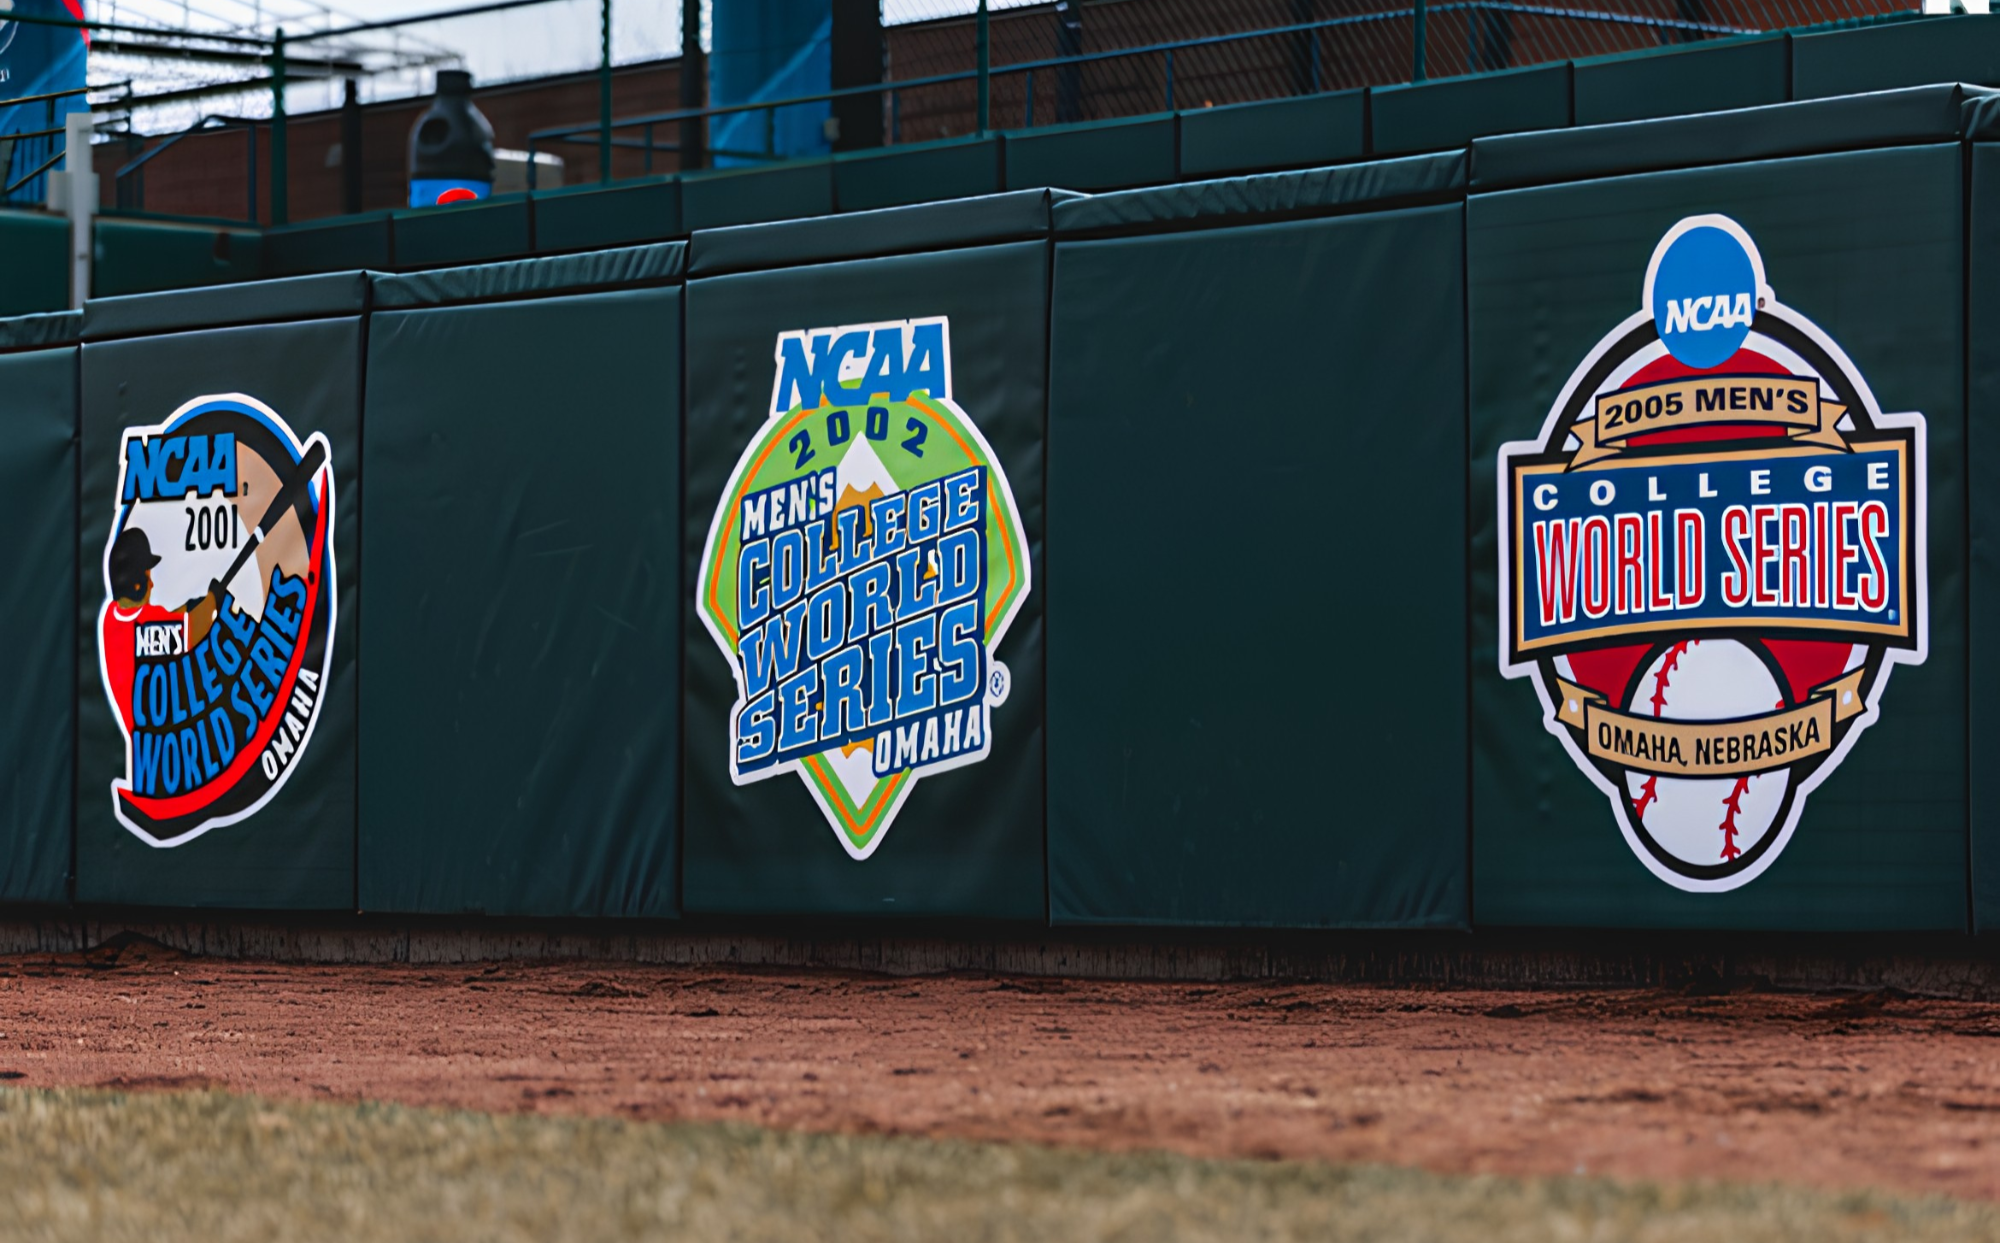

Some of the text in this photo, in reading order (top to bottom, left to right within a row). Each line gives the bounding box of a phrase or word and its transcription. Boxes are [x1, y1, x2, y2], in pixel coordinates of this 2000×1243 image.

[1665, 293, 1752, 334] NCAA
[776, 322, 946, 413] NCAA
[789, 406, 927, 470] 2002
[1604, 386, 1809, 429] 2005 MEN'S
[122, 432, 238, 505] NCAA
[1533, 462, 1889, 510] COLLEGE
[185, 504, 238, 551] 2001
[742, 470, 834, 541] MEN'S
[739, 468, 979, 630] COLLEGE
[1533, 500, 1889, 626] WORLD SERIES
[136, 622, 184, 657] MEN'S
[738, 528, 980, 700] WORLD
[132, 567, 308, 795] WORLD SERIES
[133, 593, 256, 727] COLLEGE
[737, 598, 979, 764] SERIES
[261, 666, 320, 782] OMAHA
[875, 705, 982, 774] OMAHA
[1599, 716, 1820, 767] OMAHA, NEBRASKA
